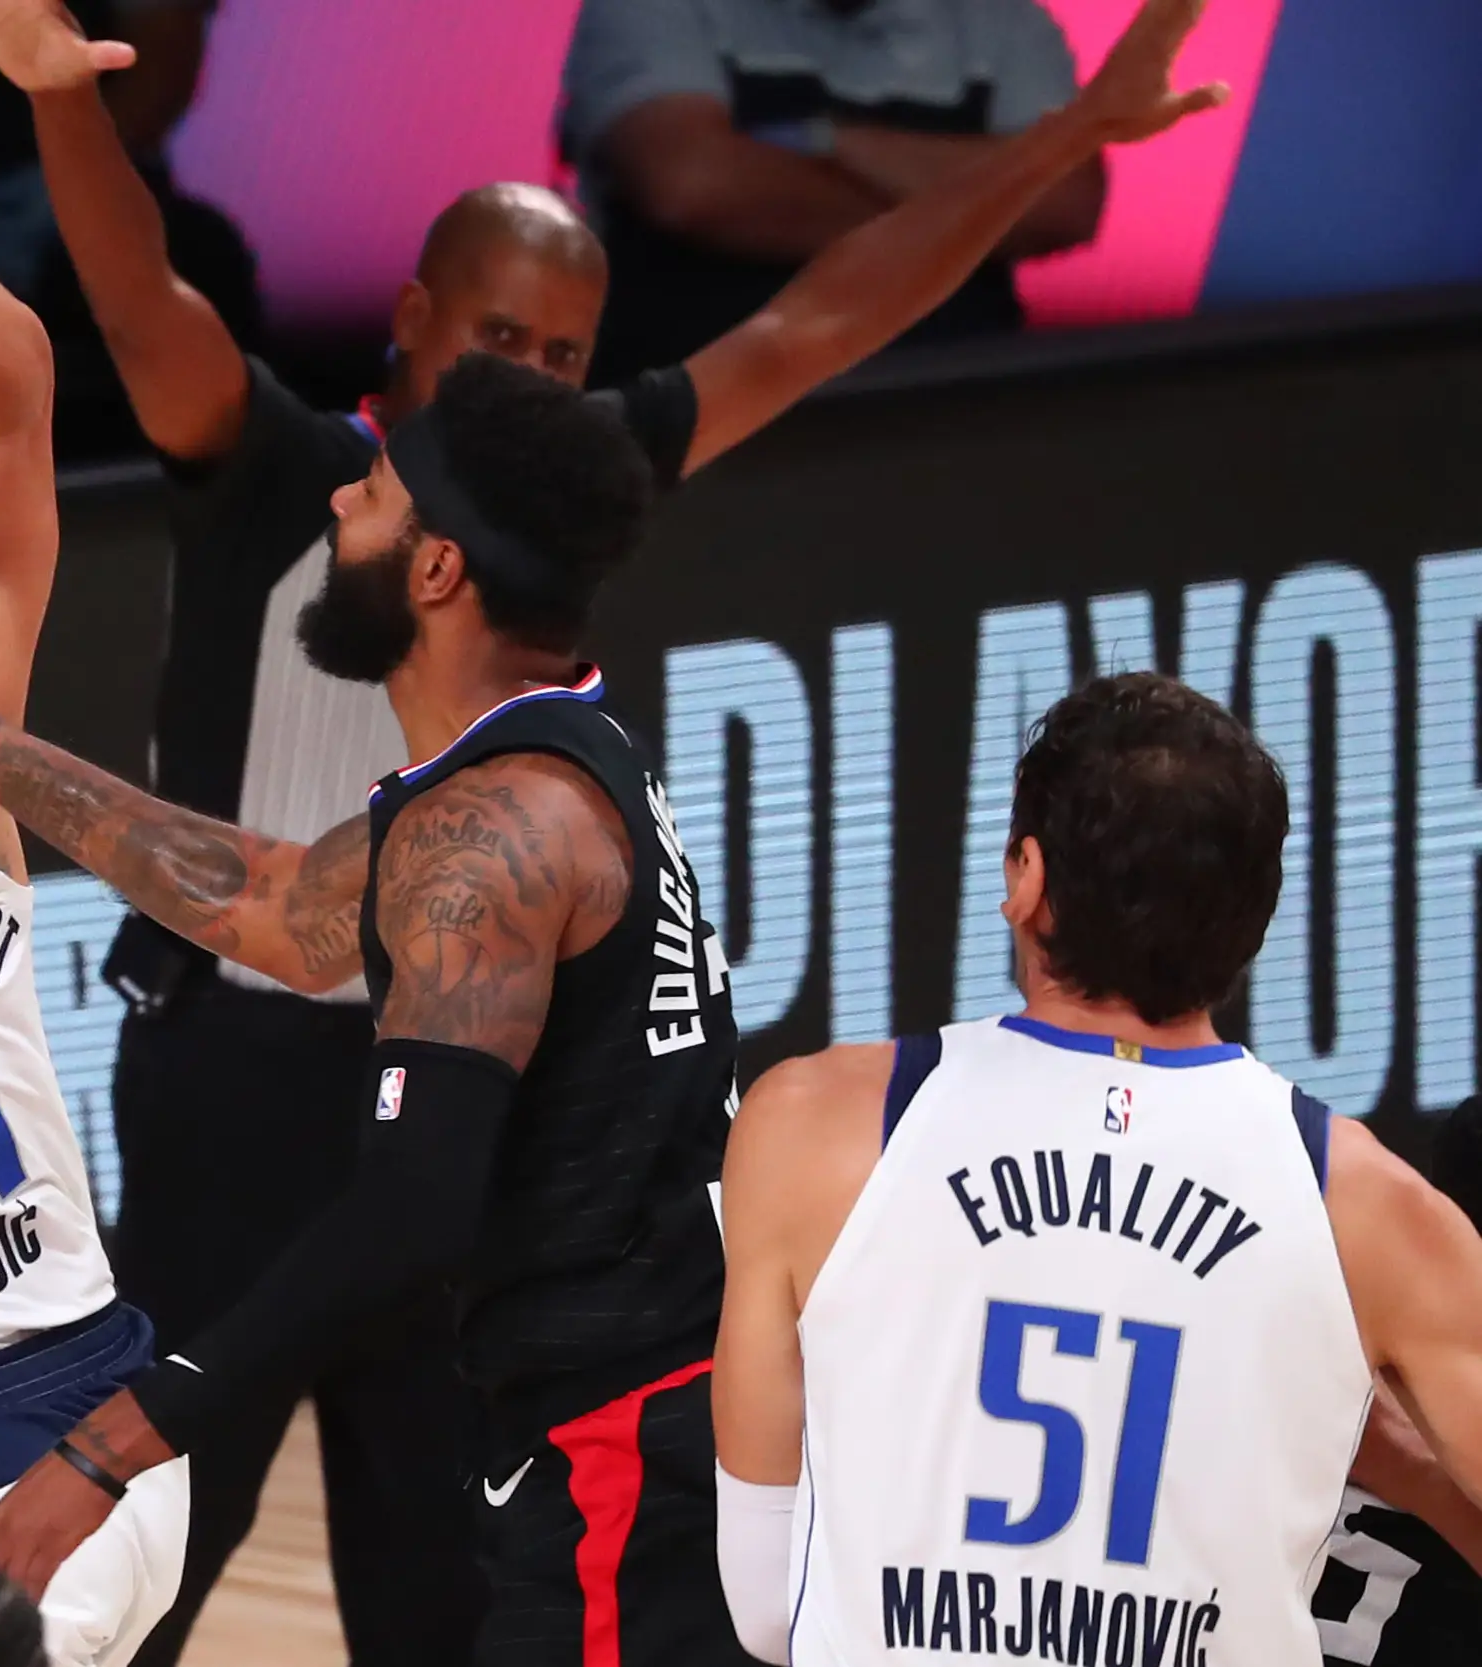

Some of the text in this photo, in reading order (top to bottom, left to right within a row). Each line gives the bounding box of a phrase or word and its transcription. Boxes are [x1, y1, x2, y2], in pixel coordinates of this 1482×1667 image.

[946, 1149, 1263, 1280] EQUALITY
[963, 1296, 1185, 1569] 51
[881, 1566, 1222, 1667] MARJANOVIĆ
